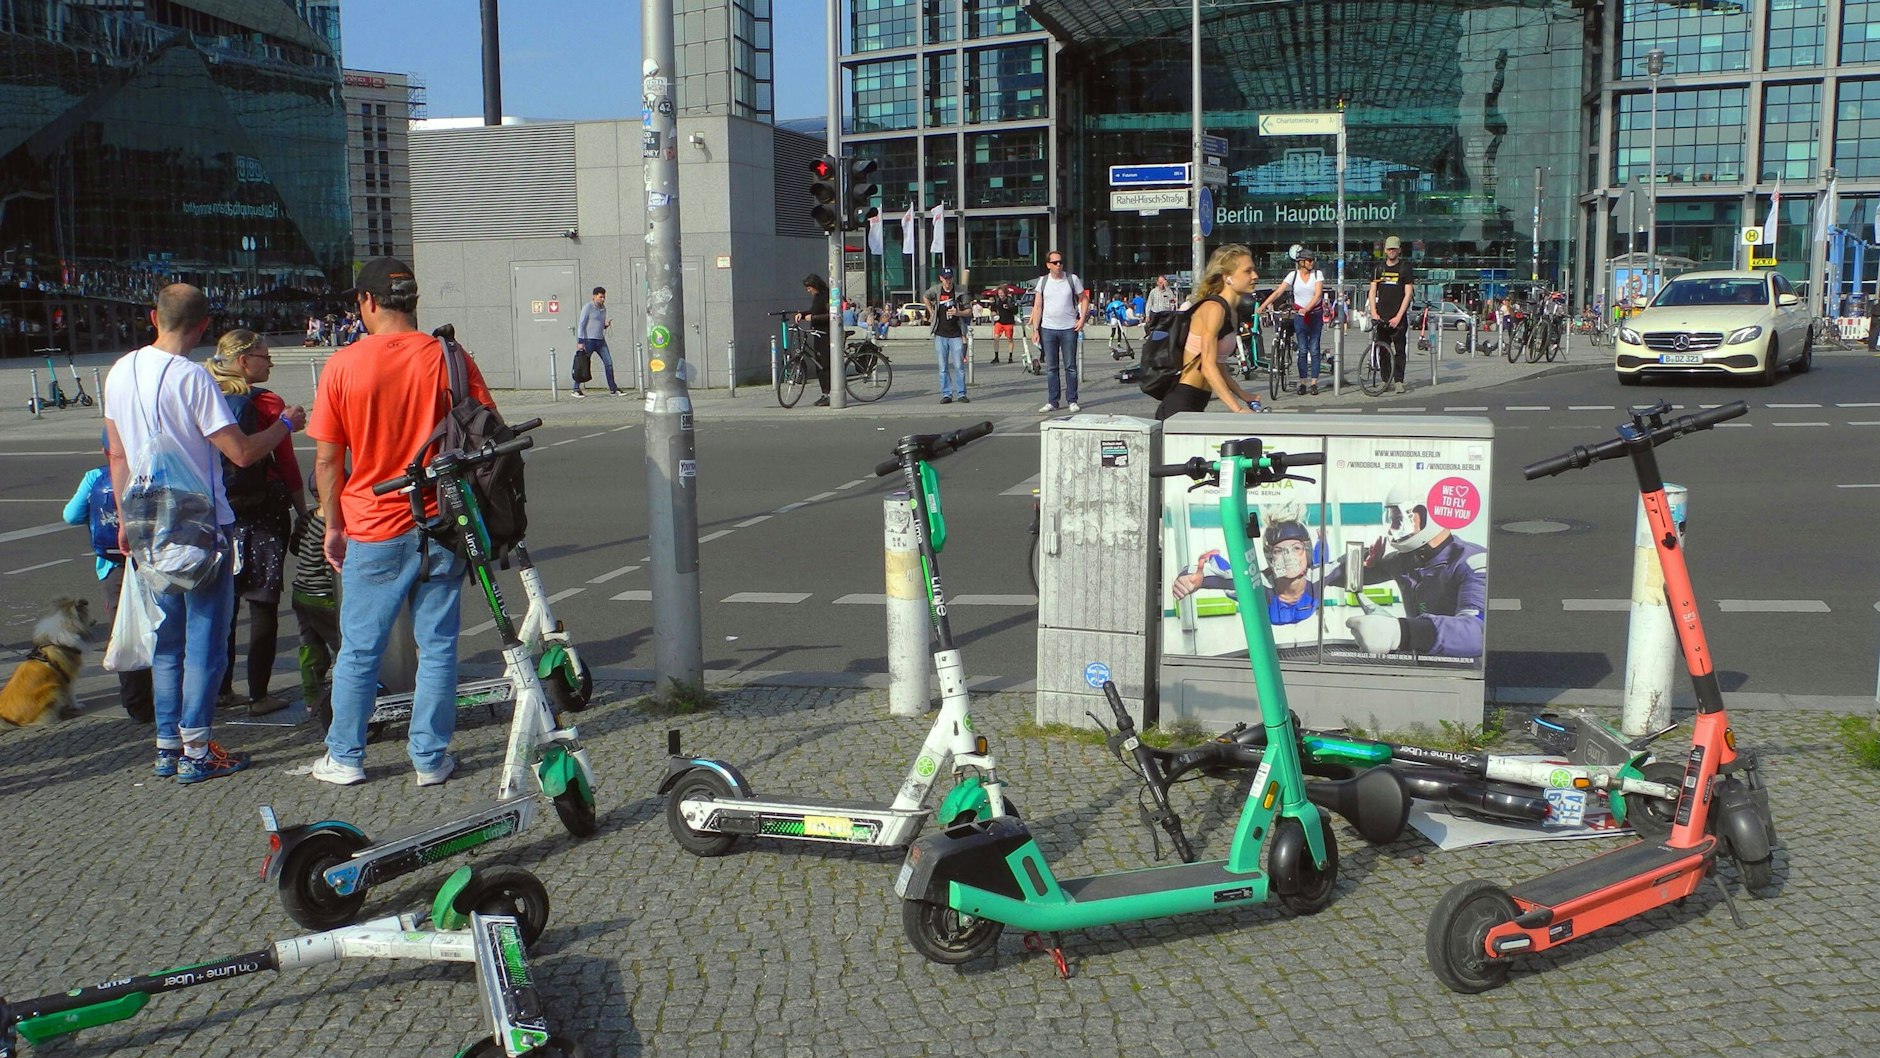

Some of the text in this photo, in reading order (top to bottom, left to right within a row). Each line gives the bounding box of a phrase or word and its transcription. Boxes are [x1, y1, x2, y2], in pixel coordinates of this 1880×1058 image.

[659, 102, 671, 112] 42
[1116, 193, 1184, 205] Rahel-Hirsch-Straße
[1216, 203, 1397, 224] Berlin Hauptbhnhof
[1686, 355, 1699, 363] 321
[1374, 450, 1441, 458] WWW.WINDOBONA.BERLIN
[1442, 485, 1454, 495] WE
[1442, 496, 1467, 508] TO FLY
[1434, 506, 1471, 520] WITH YOU!
[465, 531, 479, 557] Lime
[1245, 547, 1261, 590] Bolt
[1400, 745, 1422, 757] Uber
[1430, 750, 1453, 760] Lime
[206, 965, 237, 979] Lime
[239, 961, 259, 974] On
[164, 974, 195, 987] Uber
